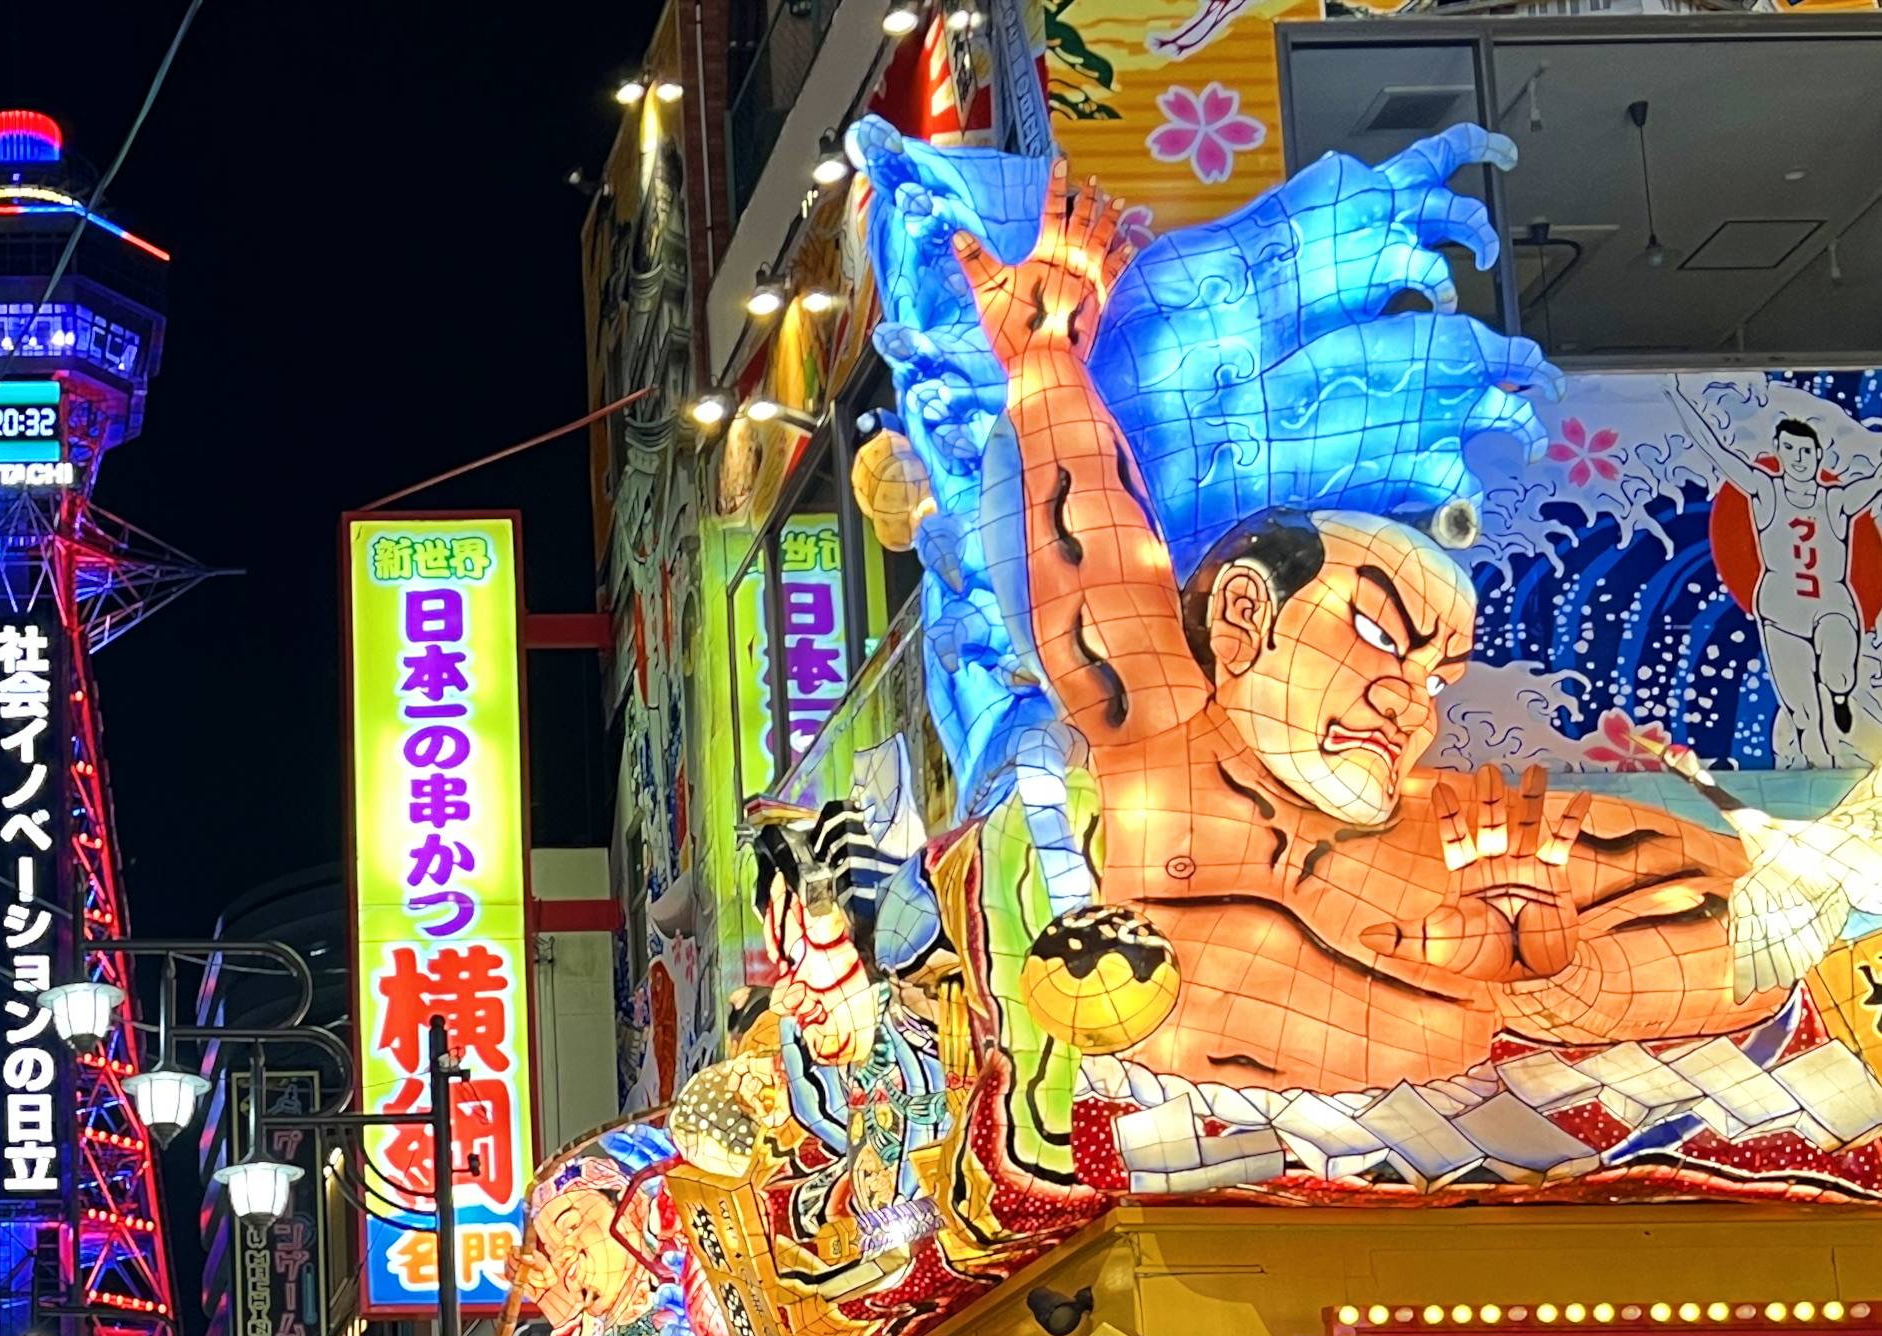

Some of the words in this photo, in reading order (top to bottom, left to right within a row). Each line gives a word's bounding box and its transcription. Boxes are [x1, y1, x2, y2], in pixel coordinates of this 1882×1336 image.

[372, 536, 493, 581] 新世界
[1786, 516, 1822, 600] グリコ
[401, 586, 476, 938] 日本一の串かつ
[376, 941, 516, 1210] 横綱
